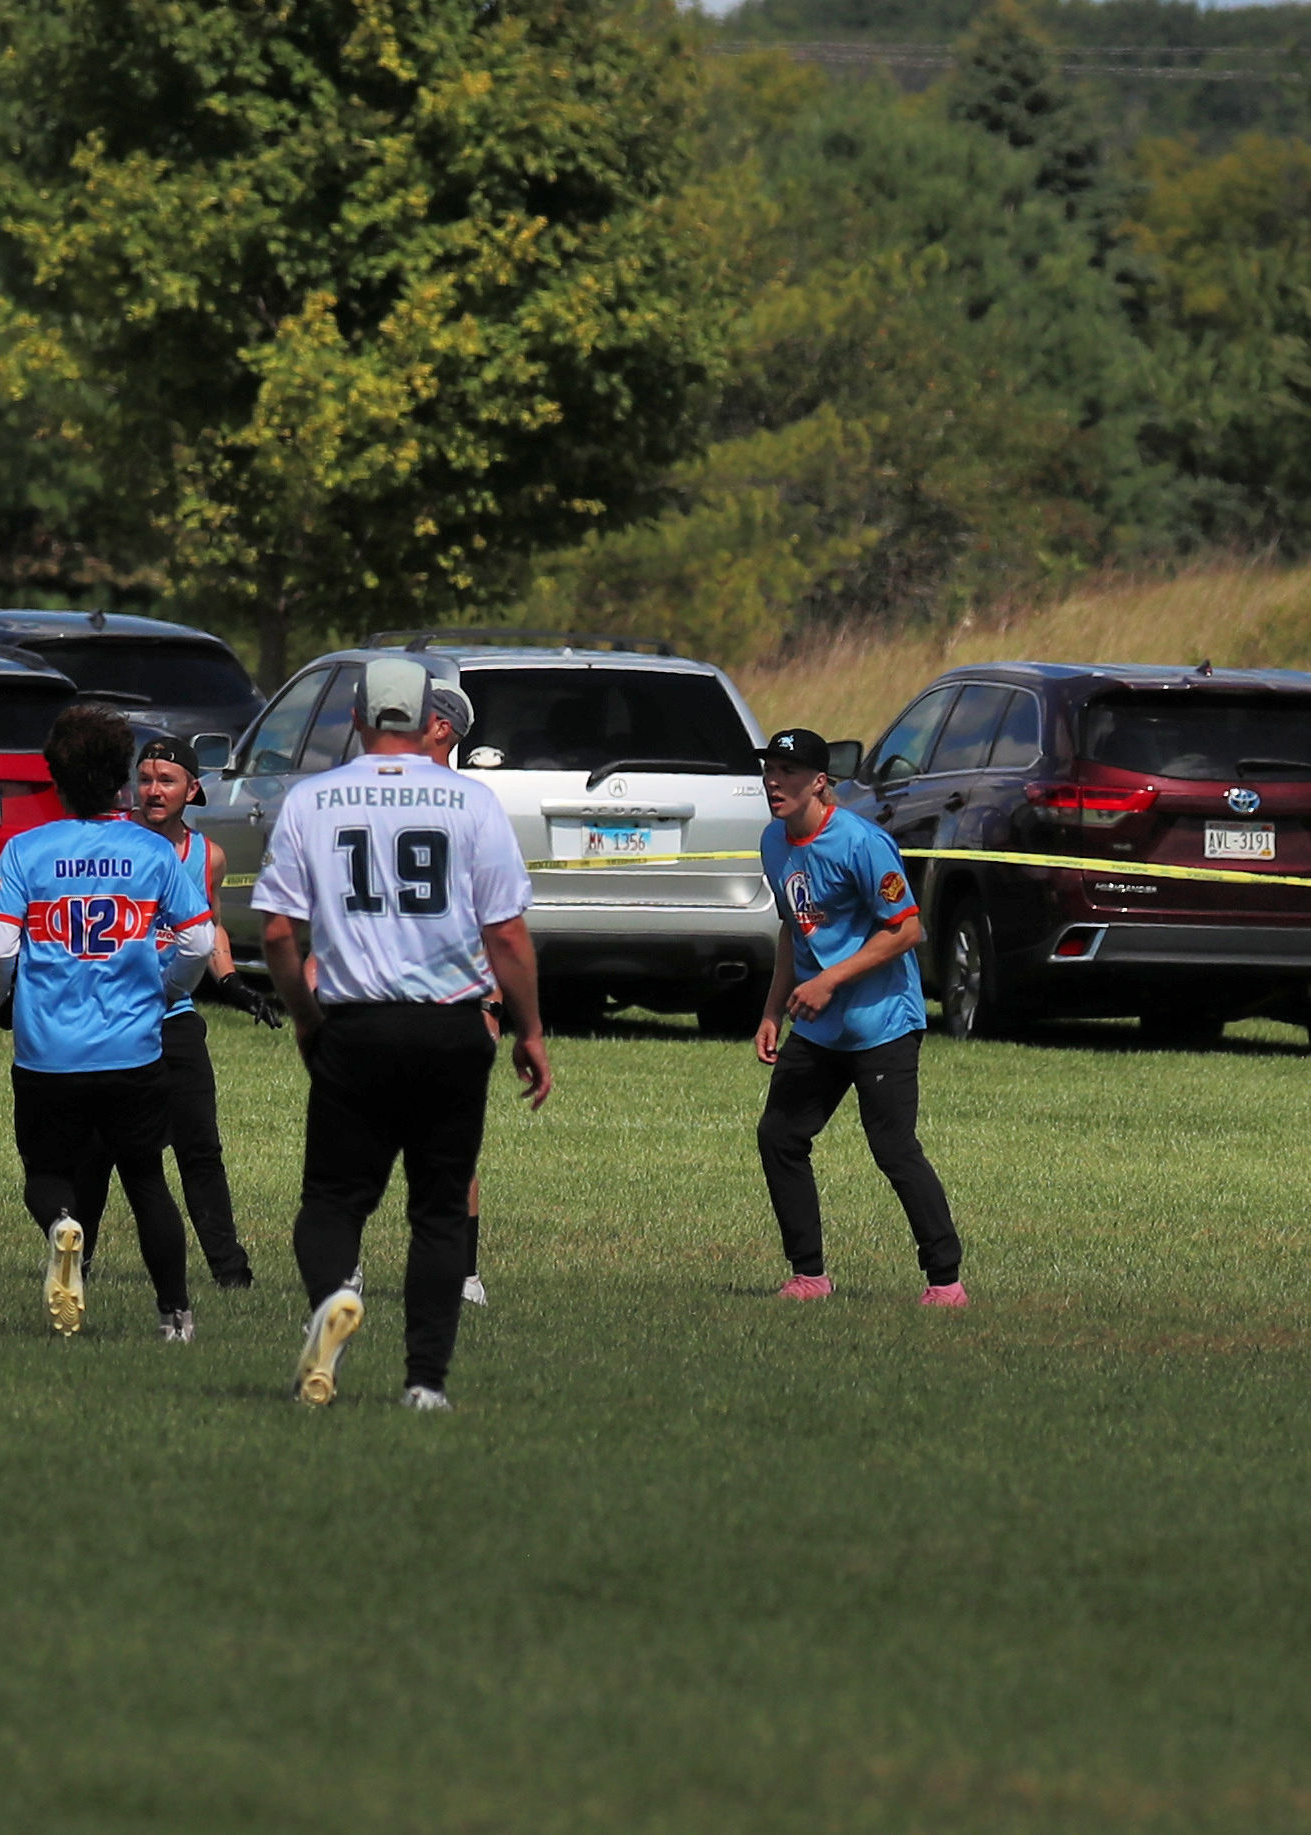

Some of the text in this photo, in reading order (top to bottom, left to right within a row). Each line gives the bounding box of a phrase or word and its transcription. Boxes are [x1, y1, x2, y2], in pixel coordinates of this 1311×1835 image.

[315, 786, 466, 810] FAUERBACH
[581, 807, 659, 816] ACURA
[588, 833, 646, 851] MK 1356
[1208, 831, 1270, 851] AVL-3191
[54, 858, 133, 879] DIPAOLO
[334, 825, 451, 918] 19
[67, 895, 119, 956] 12
